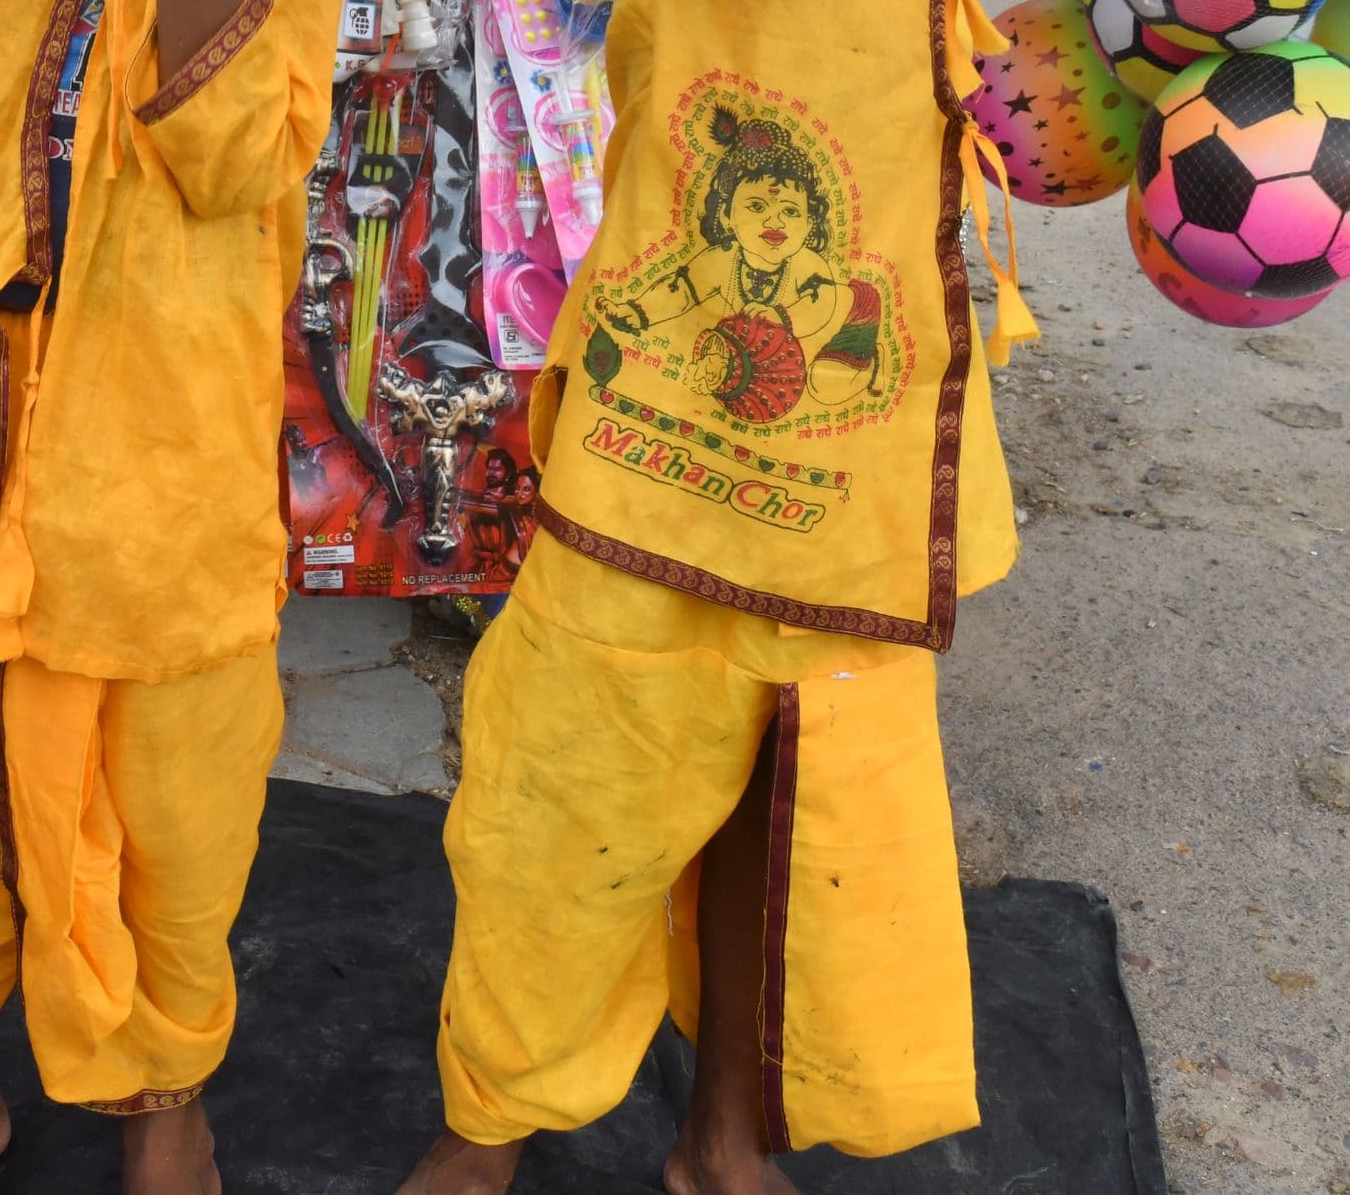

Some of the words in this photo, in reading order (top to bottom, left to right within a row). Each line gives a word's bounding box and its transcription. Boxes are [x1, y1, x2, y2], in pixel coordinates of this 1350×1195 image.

[591, 423, 726, 496] Makhan
[737, 483, 819, 527] Chor
[402, 576, 415, 585] NO
[418, 573, 486, 584] REPLACEMENT
